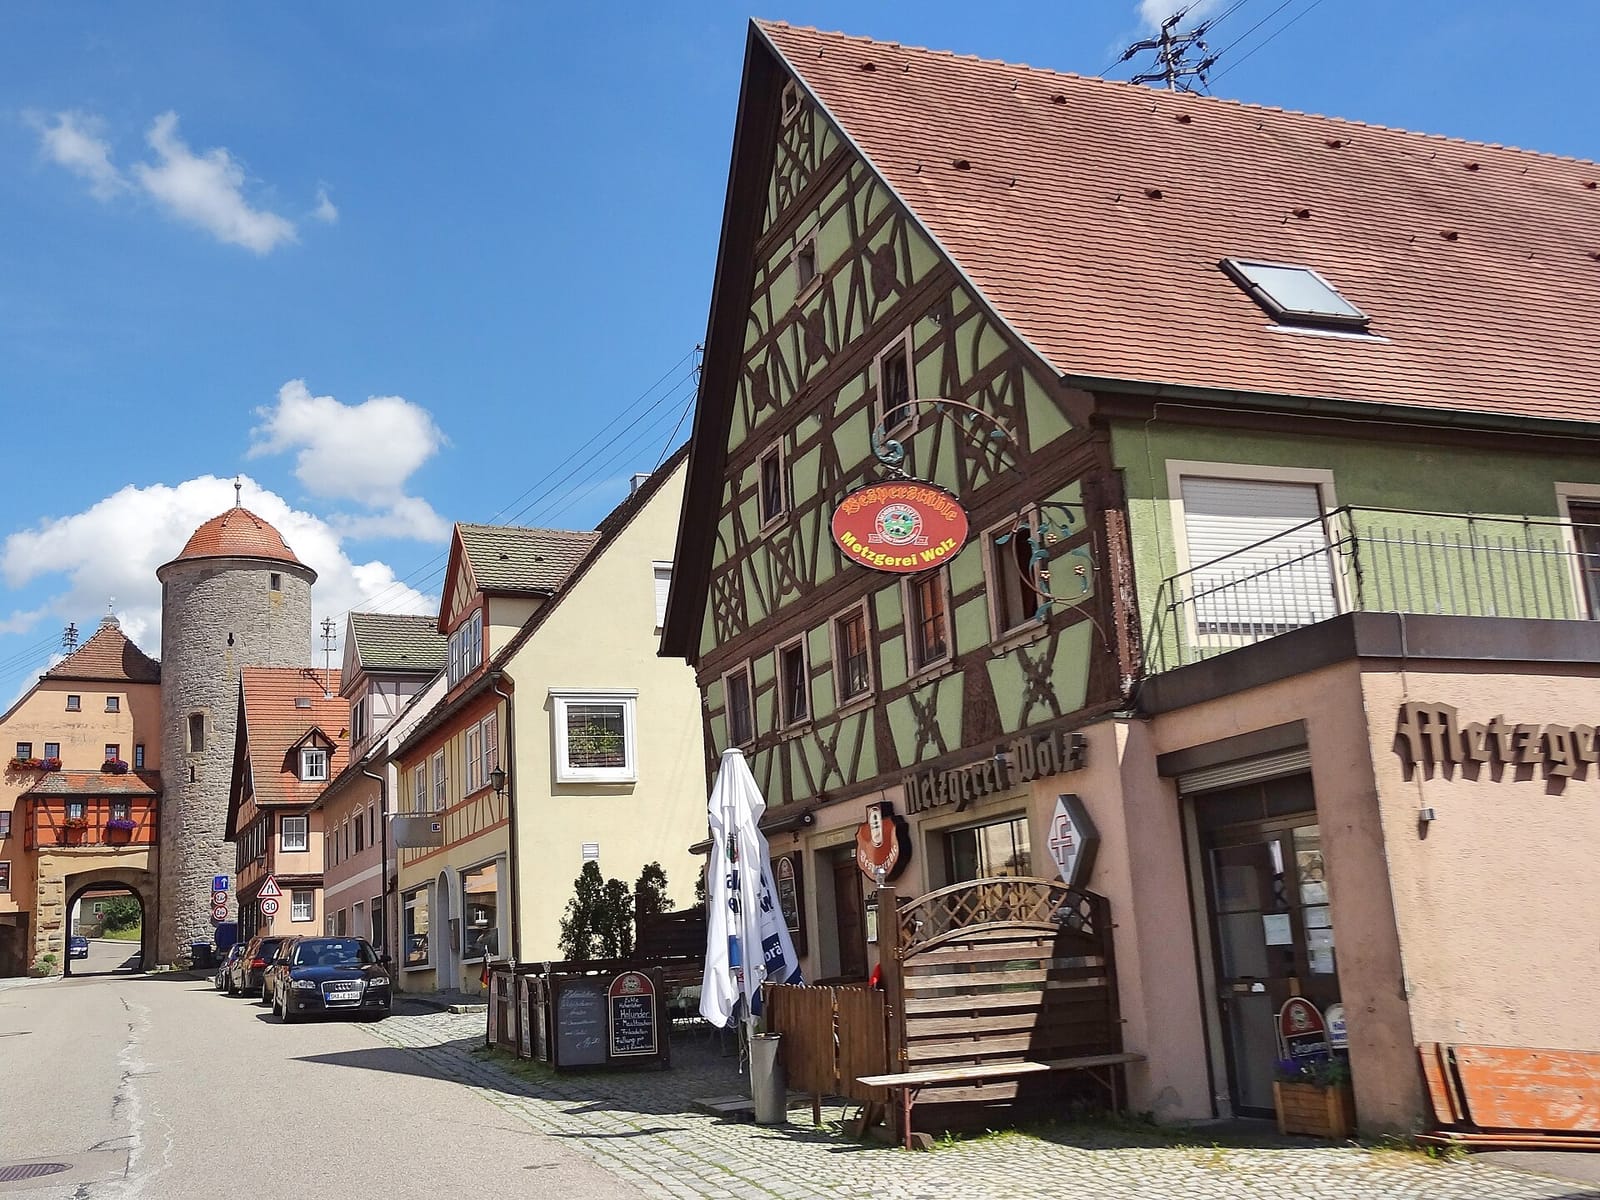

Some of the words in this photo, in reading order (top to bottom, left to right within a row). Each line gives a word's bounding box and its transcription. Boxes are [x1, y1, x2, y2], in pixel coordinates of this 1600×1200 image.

[840, 531, 918, 566] Metzgerei
[920, 537, 957, 562] Wolz
[1397, 701, 1600, 778] Metzge
[903, 749, 1004, 814] Metzgerei
[1010, 731, 1086, 784] Wolz
[265, 902, 276, 911] 30
